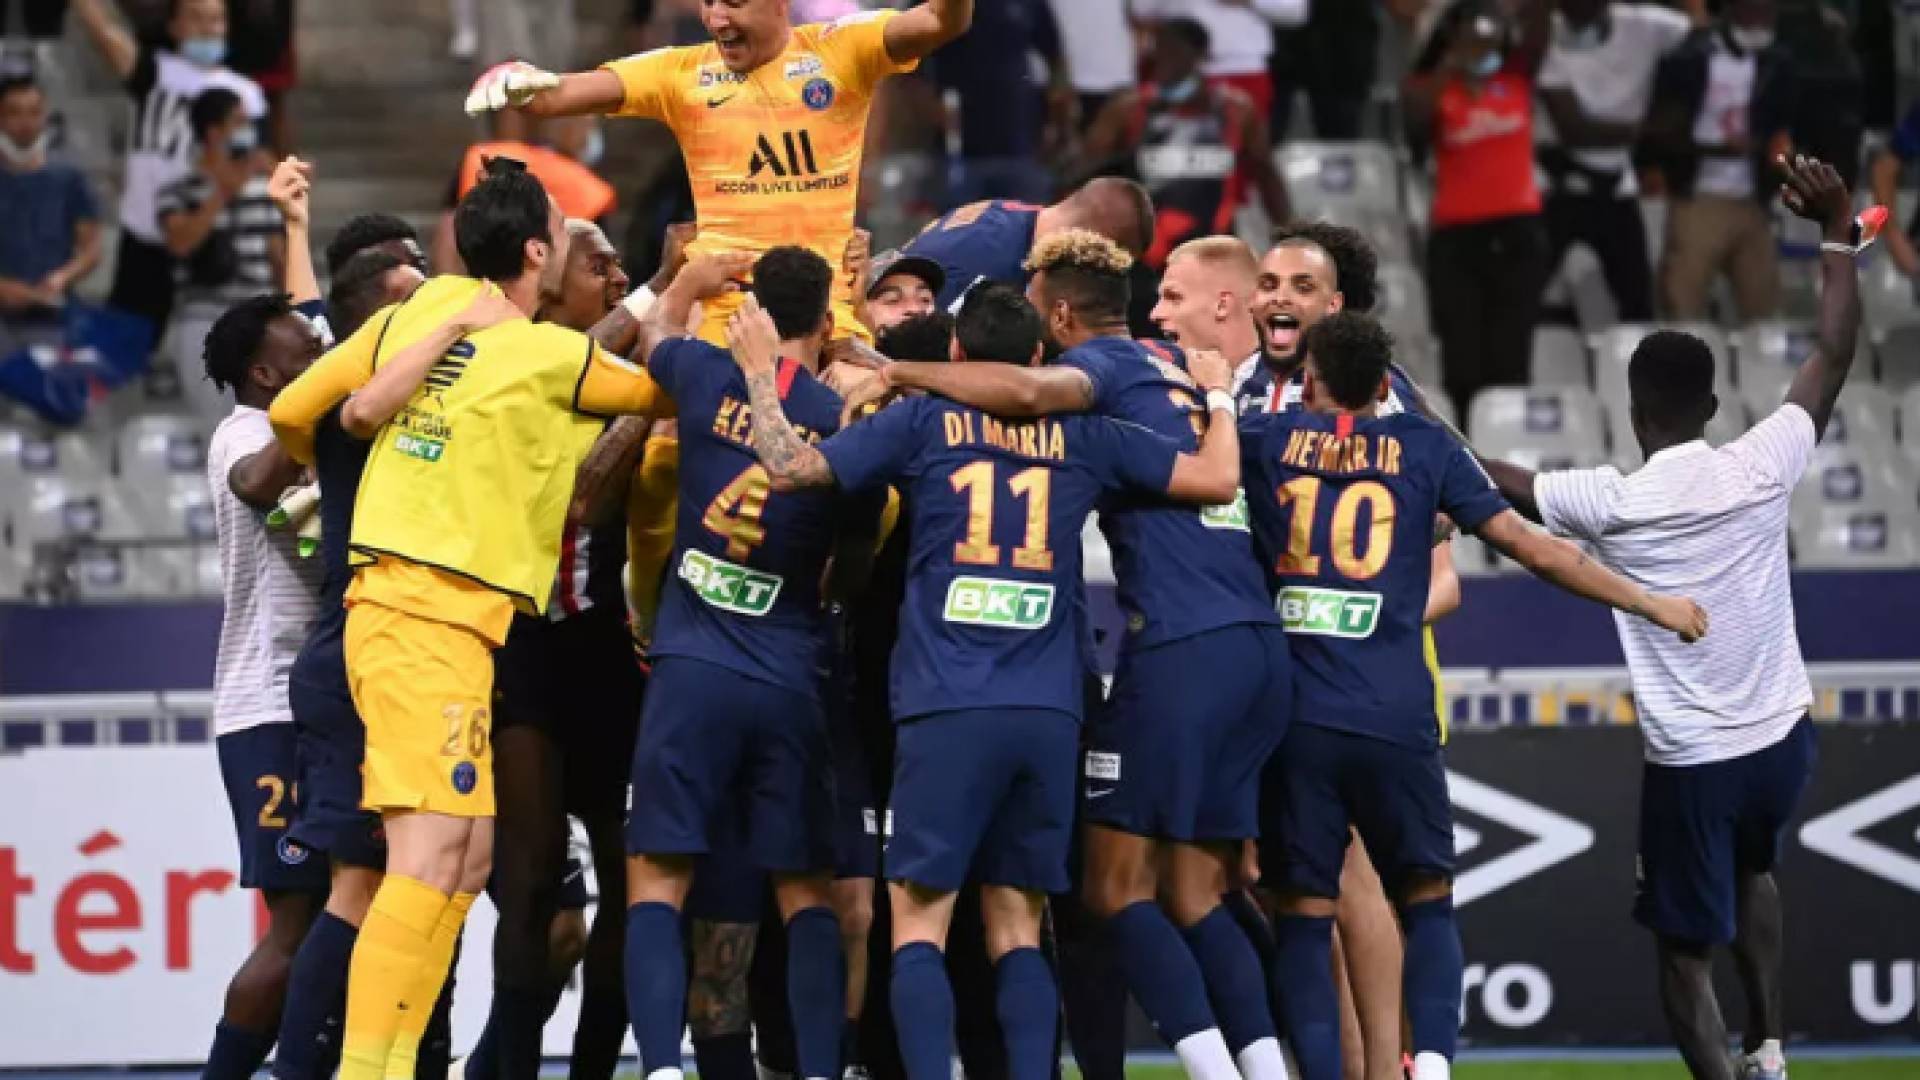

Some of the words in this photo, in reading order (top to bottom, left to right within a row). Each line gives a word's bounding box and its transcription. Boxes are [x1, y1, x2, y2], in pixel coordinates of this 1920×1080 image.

[943, 411, 976, 447] DI
[702, 462, 771, 562] 4
[948, 460, 1054, 571] 11
[1276, 474, 1397, 581] 10
[682, 556, 774, 606] BKT
[952, 585, 1048, 620] BKT
[1279, 596, 1376, 631] BKT
[256, 774, 298, 828] 2
[0, 828, 272, 975] tér
